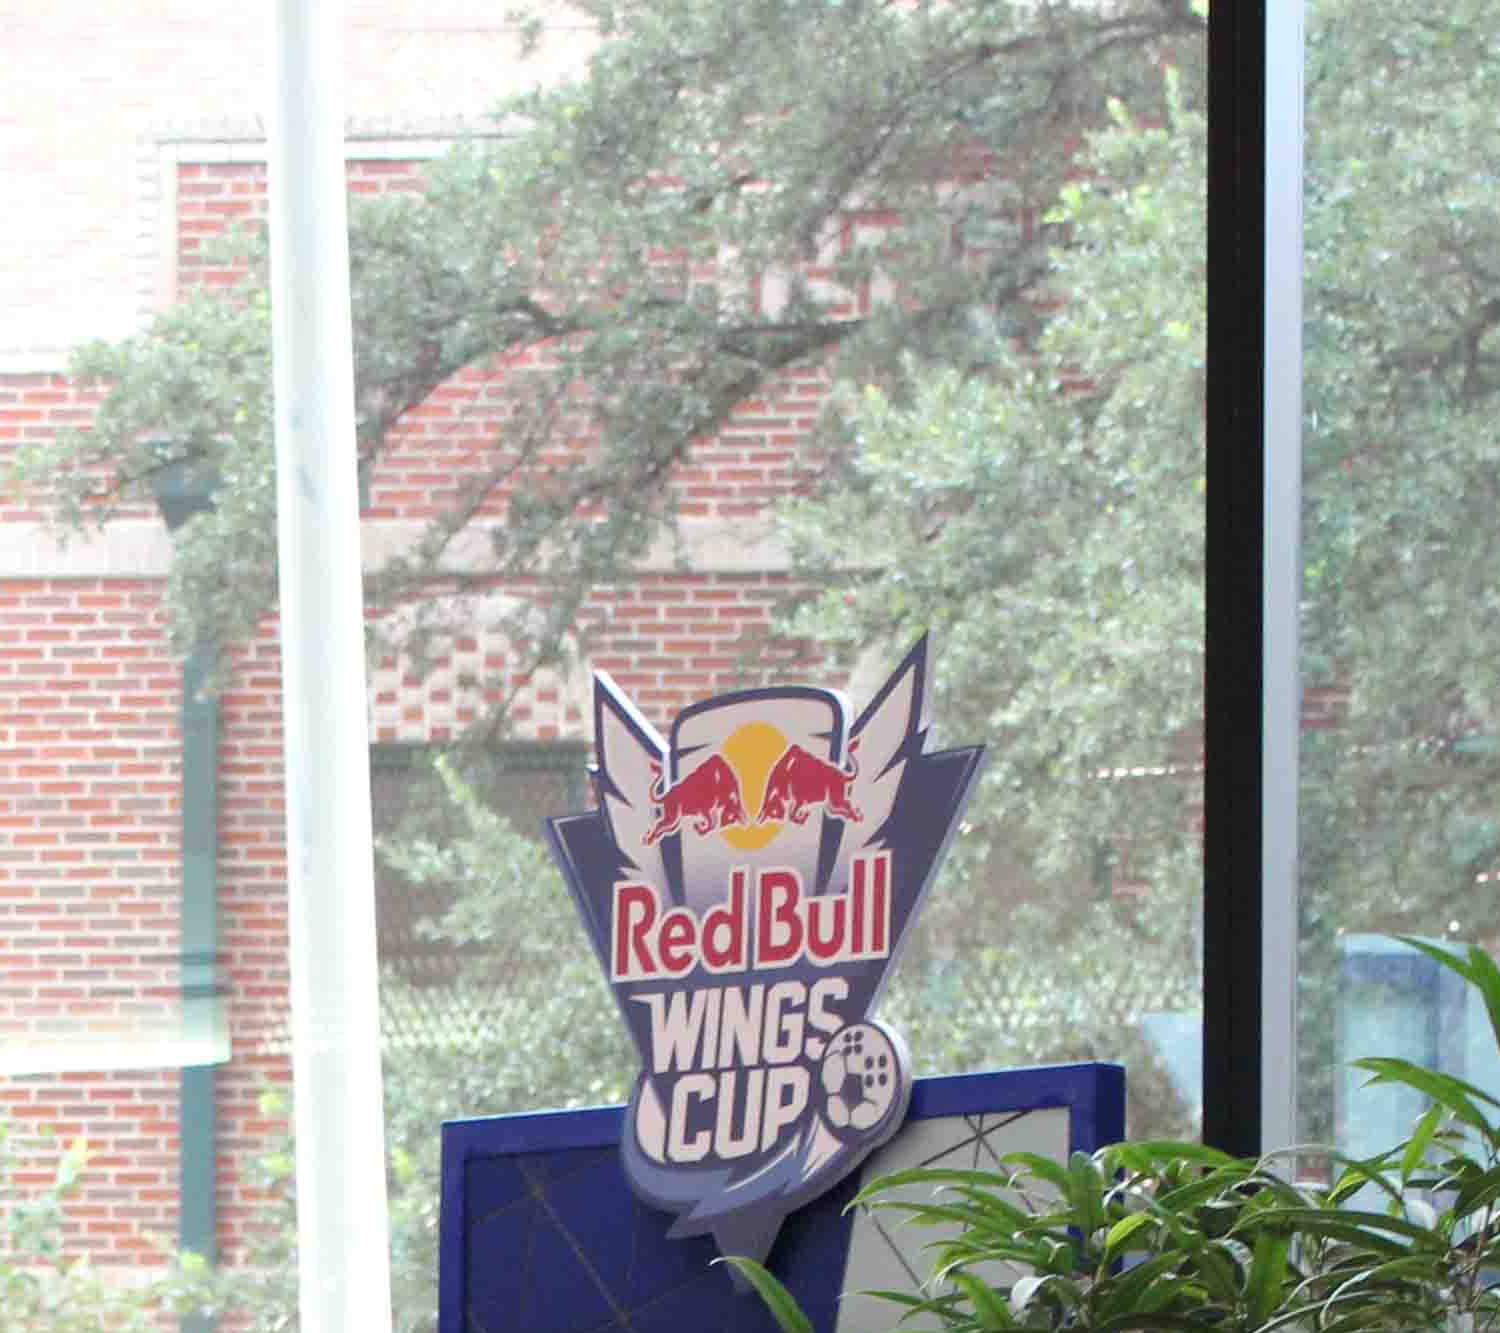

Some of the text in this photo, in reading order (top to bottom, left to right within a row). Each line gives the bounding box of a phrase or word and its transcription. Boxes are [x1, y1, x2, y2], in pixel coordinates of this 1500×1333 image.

[614, 857, 889, 978] Red Bull
[631, 976, 850, 1074] WINGS
[665, 1065, 810, 1162] CUP
